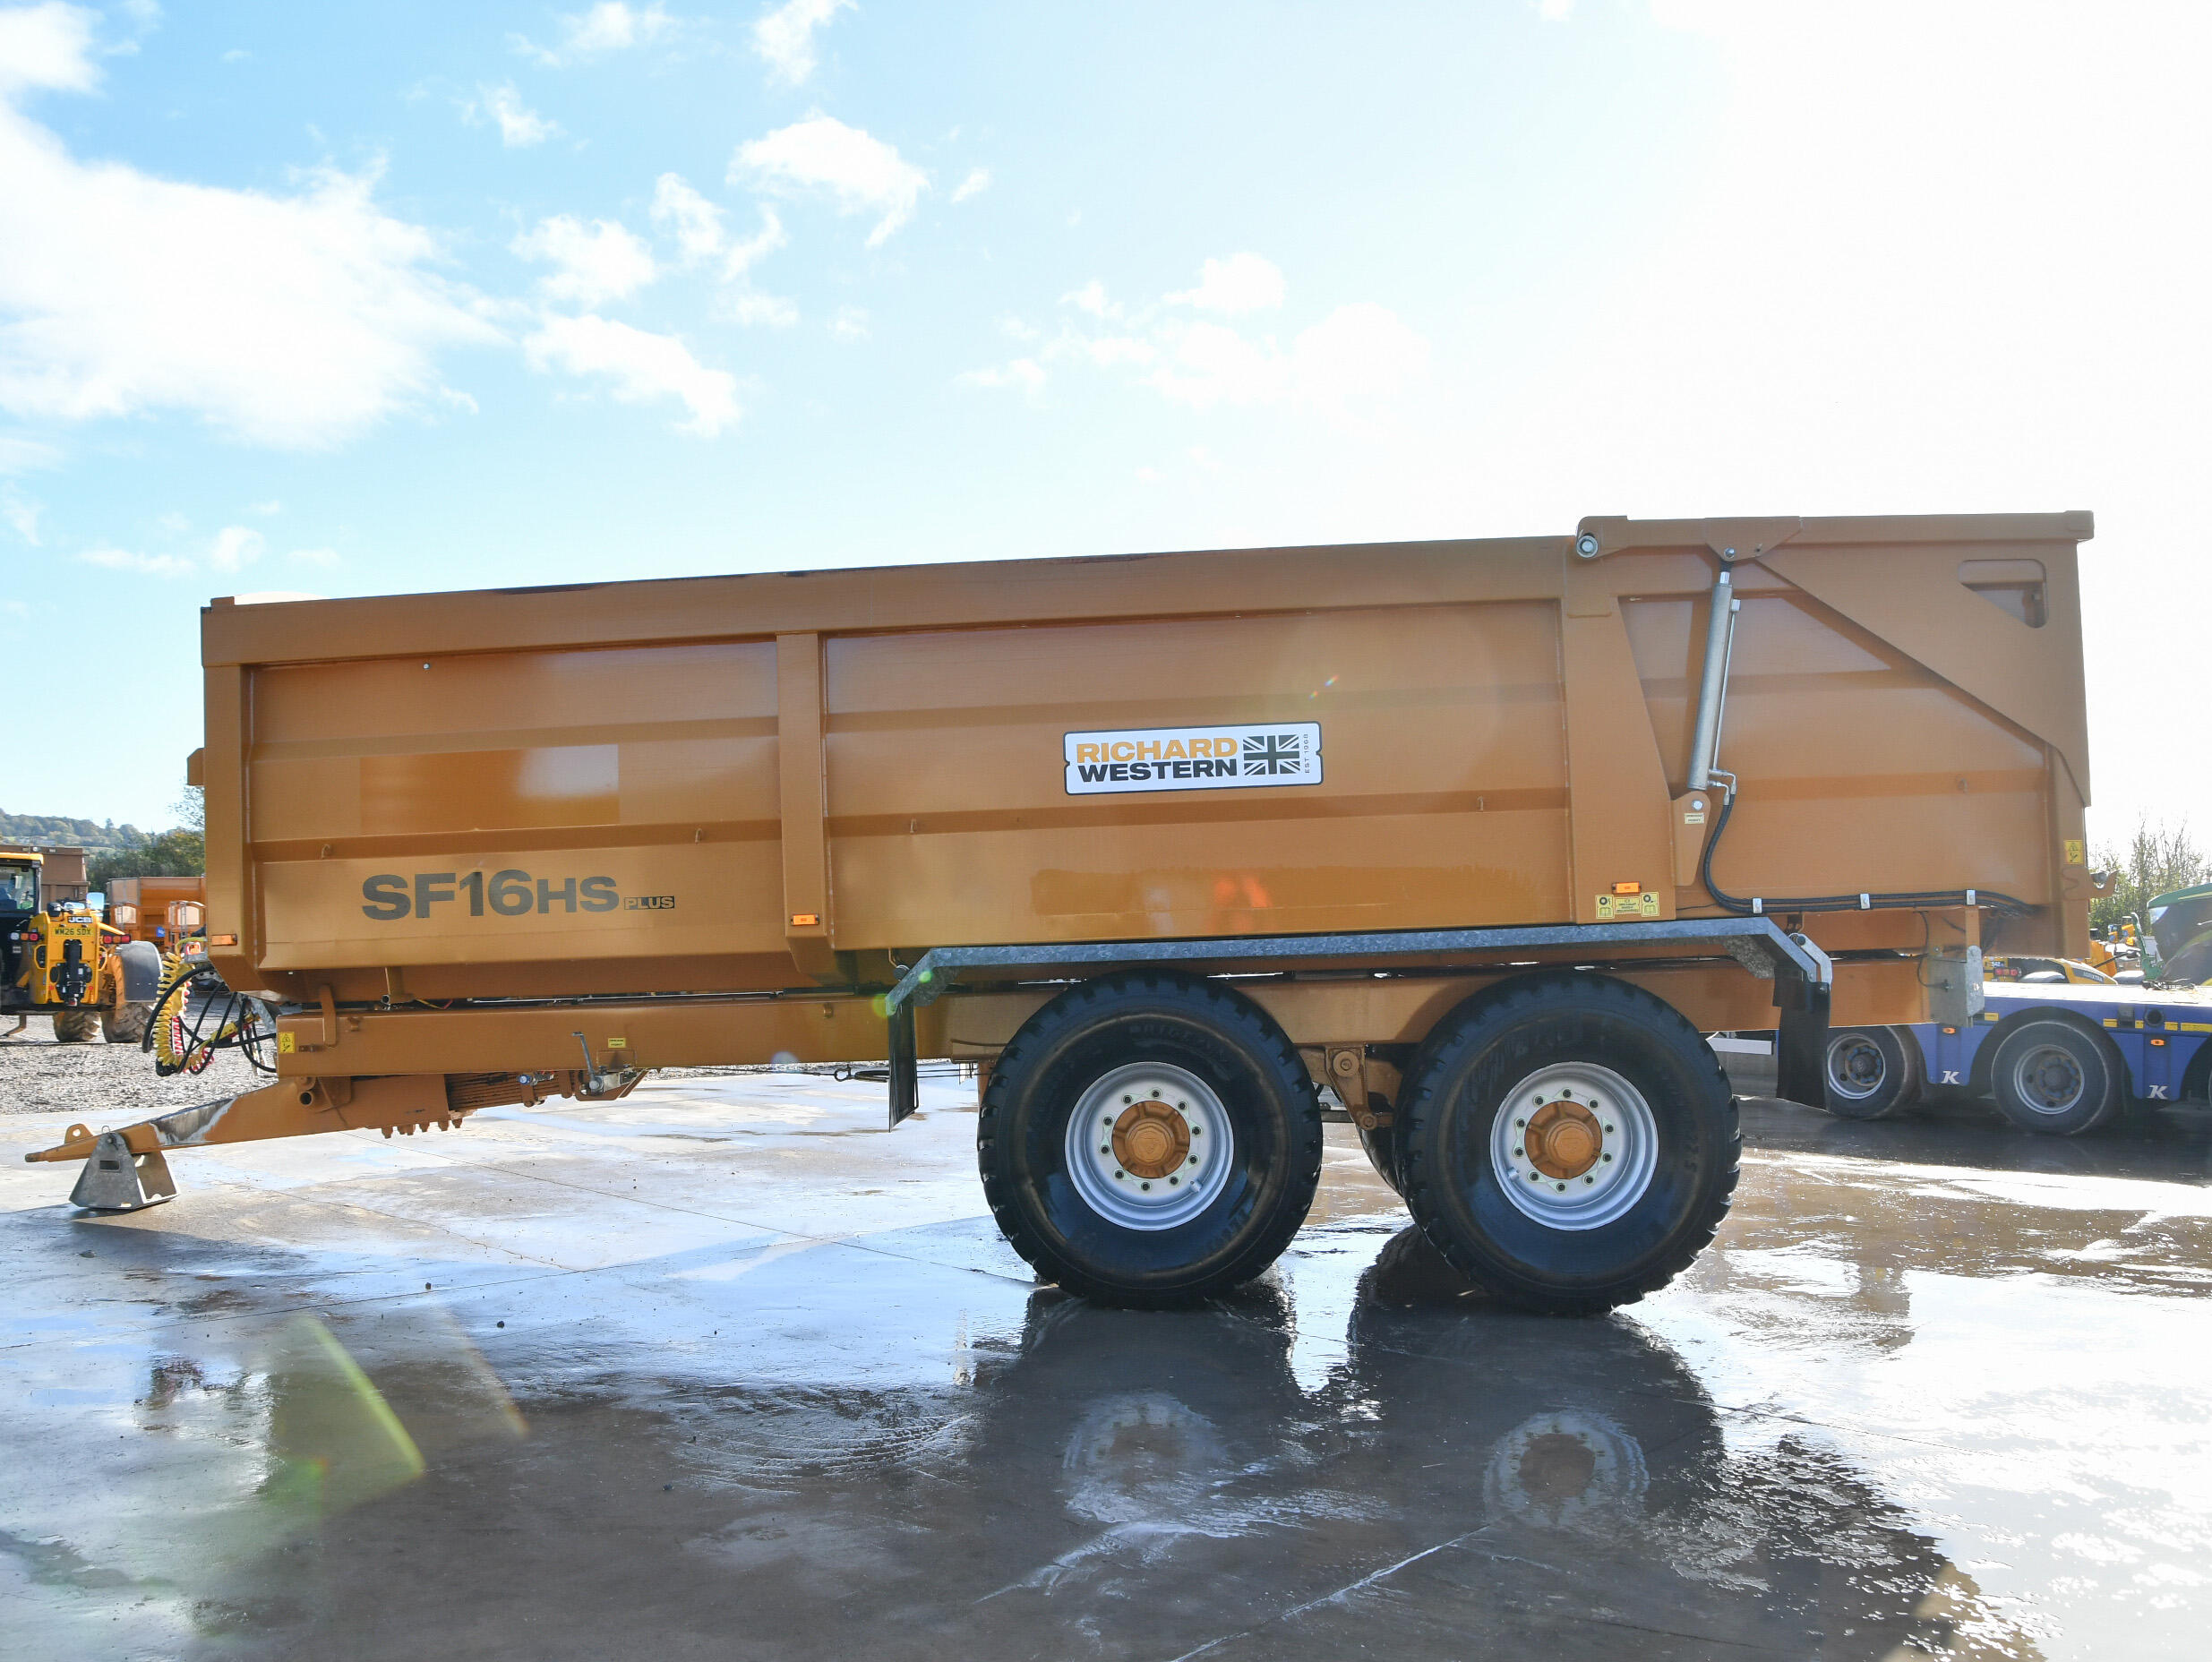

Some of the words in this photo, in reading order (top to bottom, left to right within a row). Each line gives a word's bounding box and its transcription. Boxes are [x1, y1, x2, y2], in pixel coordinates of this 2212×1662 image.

[1076, 737, 1238, 763] RICHARD
[1078, 759, 1238, 782] WESTERN
[624, 896, 674, 910] PLUS
